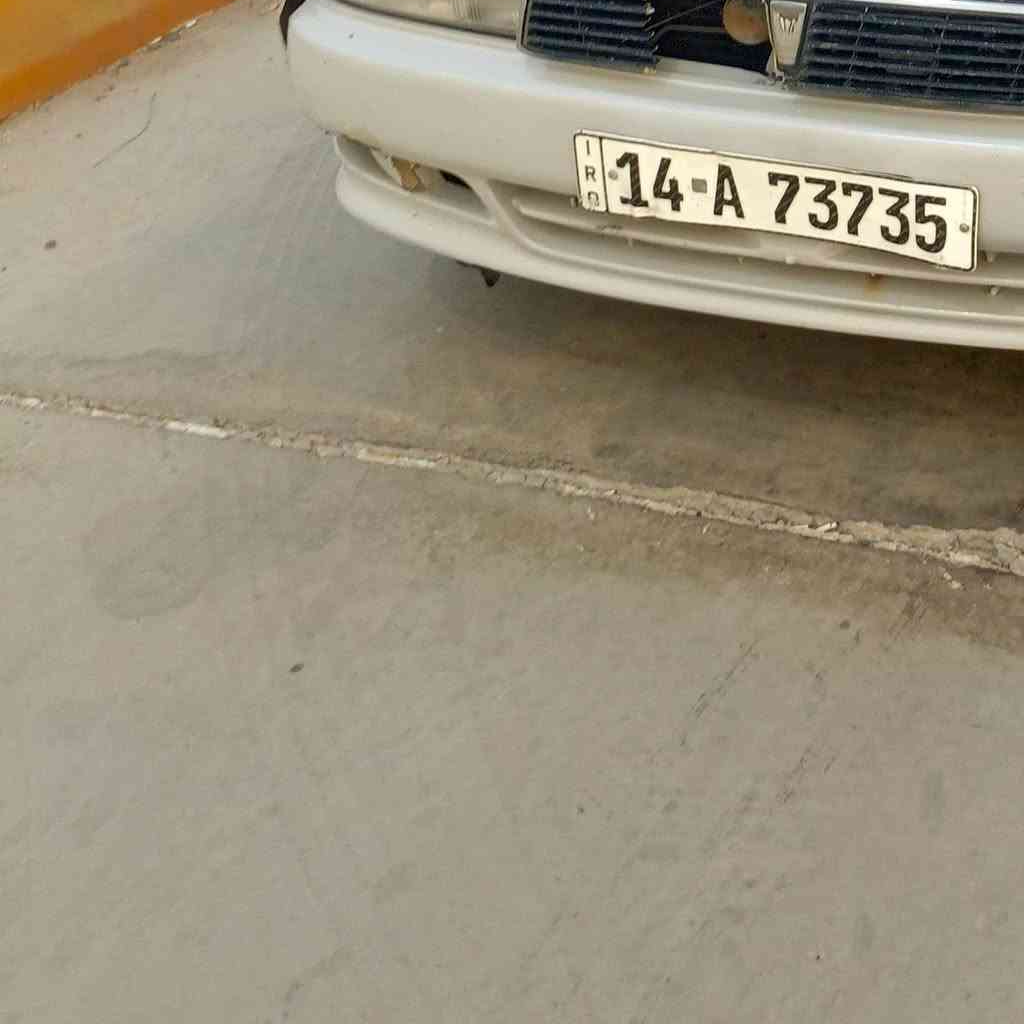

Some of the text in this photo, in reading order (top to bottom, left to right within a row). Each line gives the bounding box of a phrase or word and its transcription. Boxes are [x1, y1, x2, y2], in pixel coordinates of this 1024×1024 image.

[615, 152, 948, 254] 14 A 73735
